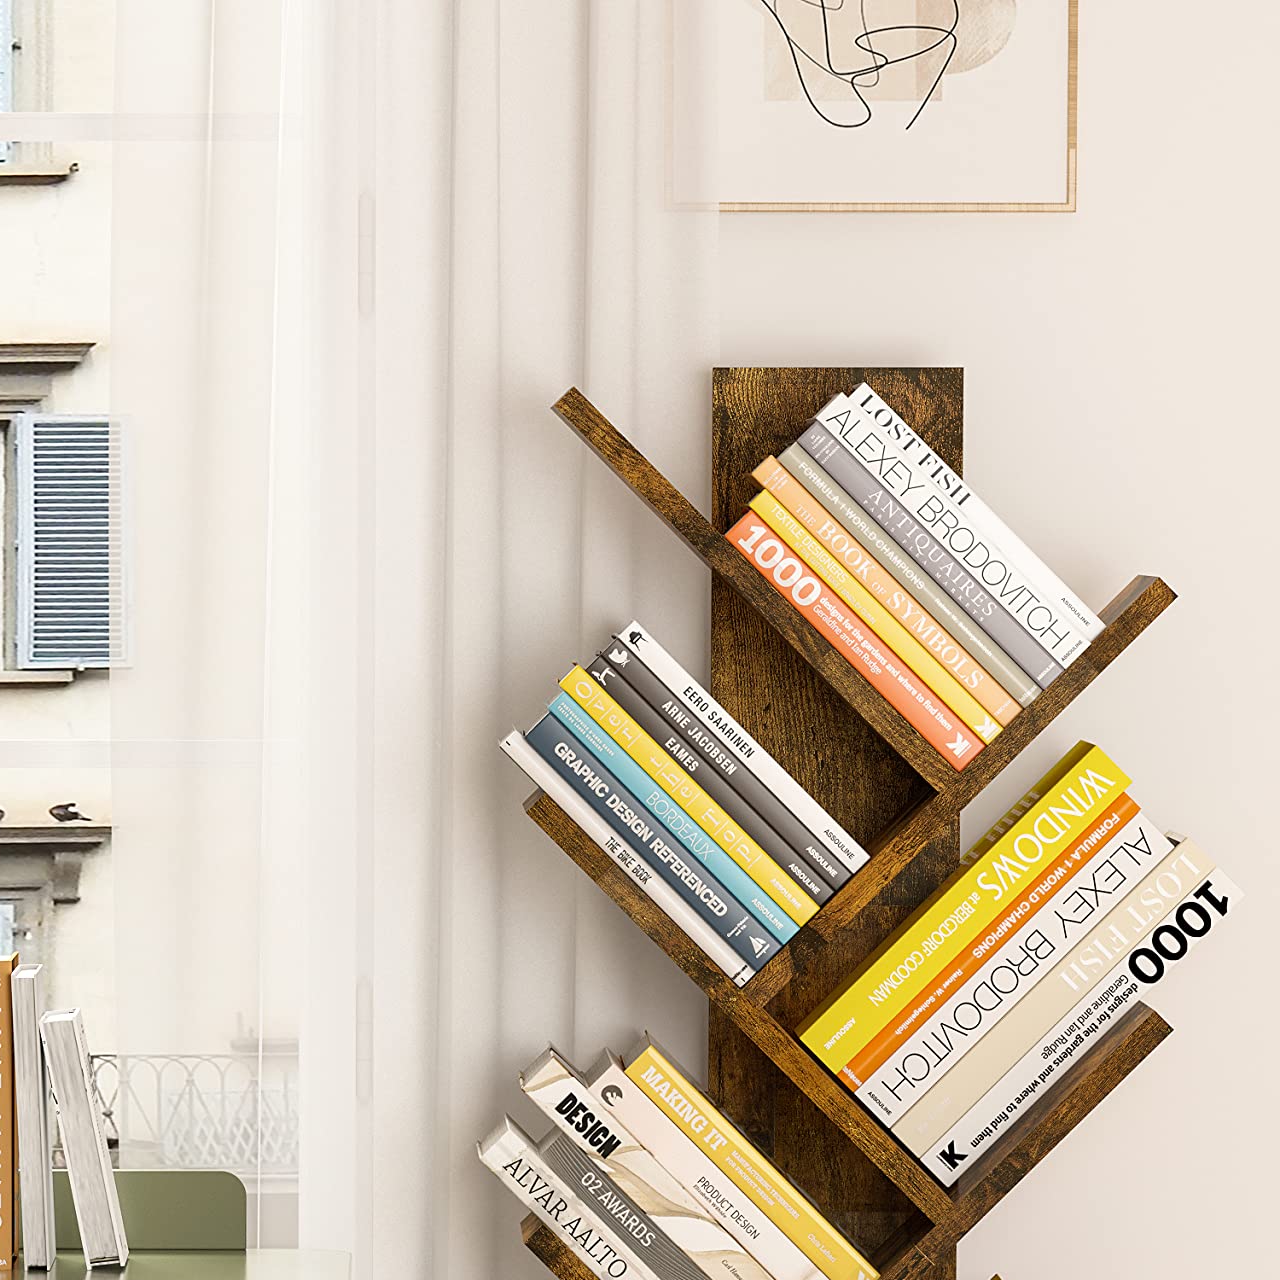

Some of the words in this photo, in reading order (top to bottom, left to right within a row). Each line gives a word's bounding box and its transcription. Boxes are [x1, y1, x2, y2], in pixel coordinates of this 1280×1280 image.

[858, 392, 922, 456] LOST
[916, 451, 971, 506] FISH
[768, 503, 805, 540] TEXTILE
[799, 534, 850, 584] DESIGNERS
[796, 460, 841, 505] FORMULA
[843, 507, 878, 542] WORLD
[873, 537, 926, 590] CHAMPIONS
[824, 403, 926, 503] ALEXEY
[914, 494, 1072, 649] BRODOVITCH
[734, 519, 827, 611] 1000
[864, 485, 999, 619] ANTIQUAIRES
[794, 504, 817, 527] THE
[814, 518, 879, 582] BOOK
[869, 580, 887, 597] OF
[883, 588, 987, 690] SYMBOLS
[1059, 596, 1091, 627] ASSOULINE
[811, 603, 844, 636] Geraldine
[838, 630, 855, 647] and
[849, 642, 865, 657] Ian
[858, 652, 883, 676] Rudge
[817, 595, 846, 623] designs
[841, 618, 854, 631] for
[850, 627, 865, 642] the
[859, 637, 889, 667] gardens
[884, 661, 900, 677] and
[895, 673, 919, 696] where
[914, 692, 925, 703] to
[921, 699, 938, 715] find
[933, 710, 954, 731] them
[660, 698, 691, 729] ARNE
[685, 723, 738, 776] JACOBSEN
[681, 685, 710, 714] EERO
[705, 709, 756, 759] SAARINEN
[663, 736, 700, 773] EAMES
[550, 739, 611, 800] GRAPHIC
[603, 792, 654, 843] DESIGN
[646, 836, 731, 919] REFERENCED
[643, 789, 716, 861] BORDEAUX
[822, 827, 855, 860] ASSOULINE
[973, 760, 1116, 903] WINDOWS
[1069, 811, 1120, 862] FORMULA
[602, 835, 621, 854] THE
[615, 848, 636, 869] BIKE
[630, 863, 652, 885] BOOK
[787, 861, 821, 895] ASSOULINE
[804, 844, 838, 878] ASSOULINE
[1026, 863, 1067, 904] WORLD
[1045, 825, 1160, 940] ALEXEY
[1062, 857, 1074, 868] 1
[749, 896, 784, 931] ASSOULINE
[966, 890, 982, 905] at
[1117, 850, 1202, 935] LOST
[917, 899, 976, 957] BERGDORF
[970, 898, 1032, 960] CHAMPIONS
[1121, 876, 1235, 991] 1000
[866, 948, 926, 1007] GOODMAN
[940, 967, 963, 990] Rainer
[1056, 921, 1130, 995] FISH
[880, 927, 1056, 1103] BRODOVITCH
[932, 986, 944, 998] W.
[1076, 1006, 1095, 1026] and
[1089, 972, 1130, 1013] Geraldine
[1094, 1009, 1111, 1026] for
[1105, 980, 1140, 1015] designs
[822, 1016, 857, 1050] ASSOULINE
[1038, 1031, 1068, 1062] Rudge
[1051, 1033, 1086, 1068] gardens
[1063, 1020, 1081, 1039] Ian
[1081, 1021, 1099, 1039] the
[1013, 1077, 1042, 1107] where
[1036, 1063, 1056, 1083] and
[553, 1091, 622, 1160] DESIGN
[638, 1063, 710, 1135] MAKING
[701, 1127, 728, 1153] IT
[866, 1090, 893, 1116] ASSOULINE
[989, 1110, 1009, 1130] find
[1004, 1101, 1018, 1115] to
[969, 1125, 994, 1150] them
[501, 1152, 571, 1222] ALVAR
[696, 1175, 734, 1213] PRODUCT
[729, 1209, 761, 1240] DESIGN
[595, 1187, 657, 1248] AWARDS
